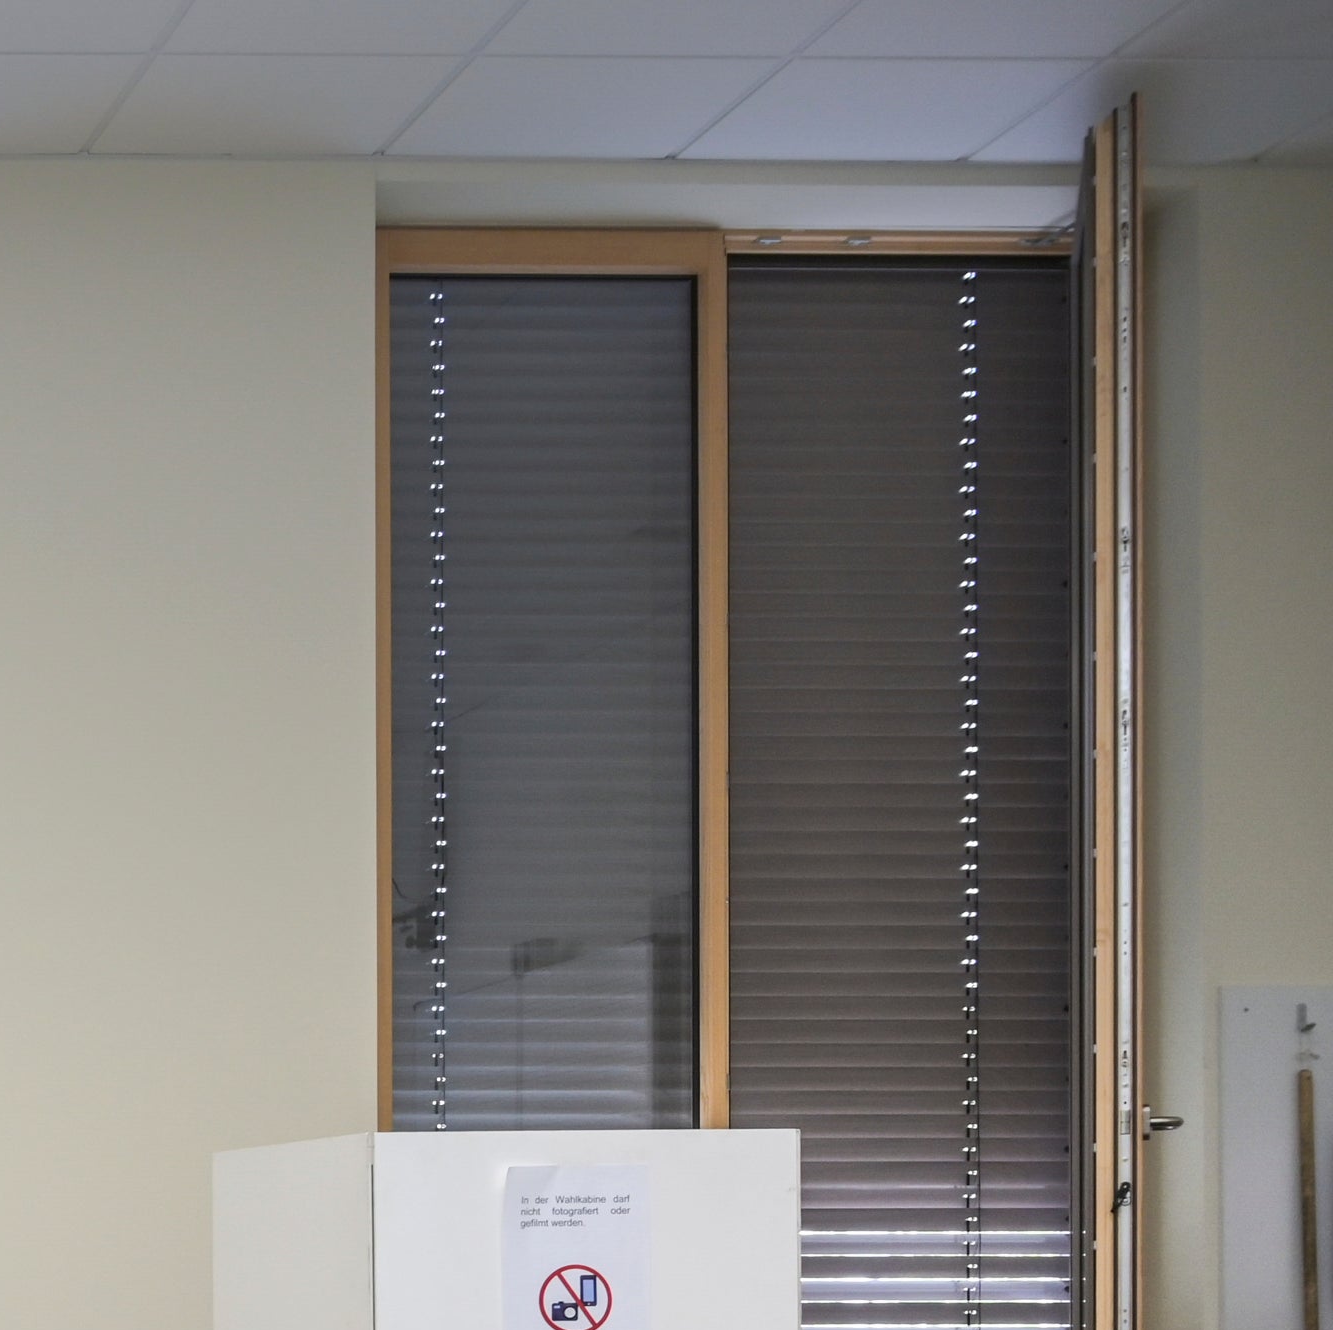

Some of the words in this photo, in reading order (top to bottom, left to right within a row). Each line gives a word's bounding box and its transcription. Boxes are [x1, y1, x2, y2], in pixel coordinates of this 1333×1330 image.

[521, 1196, 529, 1204] In
[535, 1196, 549, 1204] der
[555, 1196, 606, 1204] Wahlkabine
[613, 1195, 629, 1204] darf
[521, 1207, 540, 1216] nicht
[552, 1207, 598, 1217] fotografiert
[610, 1207, 631, 1215] oder
[520, 1219, 549, 1228] gefilmt
